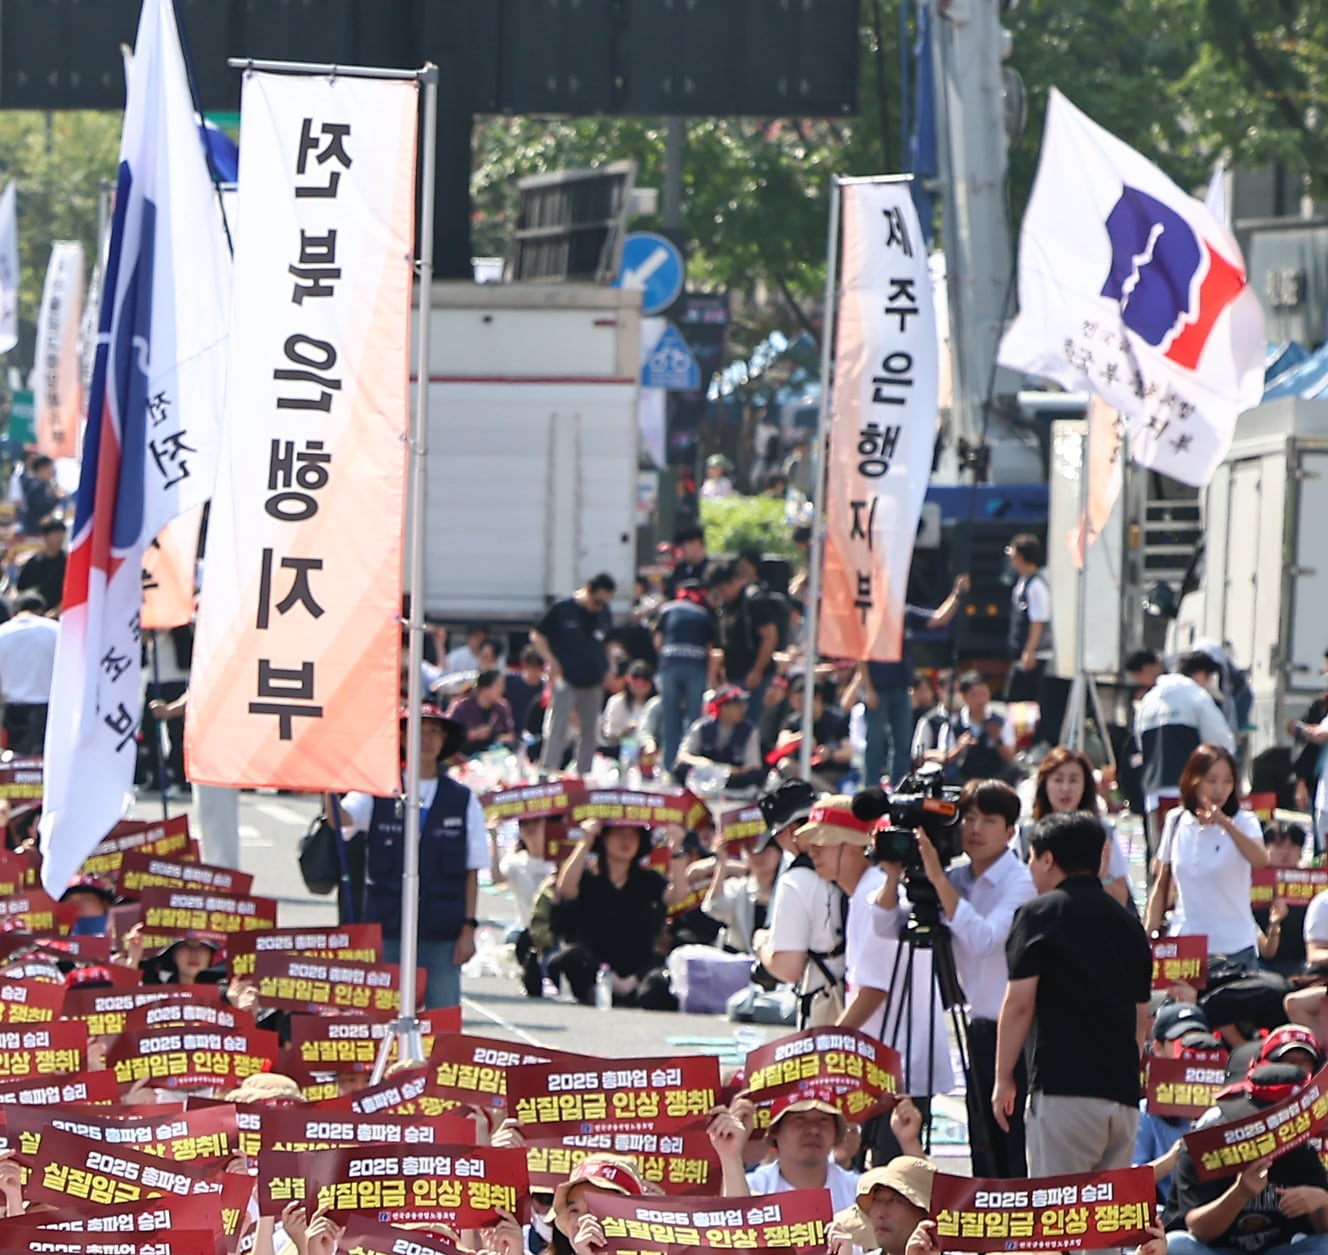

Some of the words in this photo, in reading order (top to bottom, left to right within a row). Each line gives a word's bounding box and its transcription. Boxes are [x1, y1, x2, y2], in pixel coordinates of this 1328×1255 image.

[547, 1071, 598, 1090] 2025
[601, 1069, 647, 1089] 총파업
[650, 1068, 681, 1086] 승리
[513, 1092, 607, 1125] 실질임금
[612, 1091, 659, 1118] 인상
[664, 1088, 719, 1121] 쟁취!
[974, 1190, 1029, 1208] 2025
[1030, 1185, 1078, 1208] 총파업
[1081, 1182, 1113, 1202] 승리
[931, 1209, 1034, 1238] 실질임금
[1040, 1201, 1088, 1235] 인상
[1094, 1201, 1154, 1232] 쟁취!
